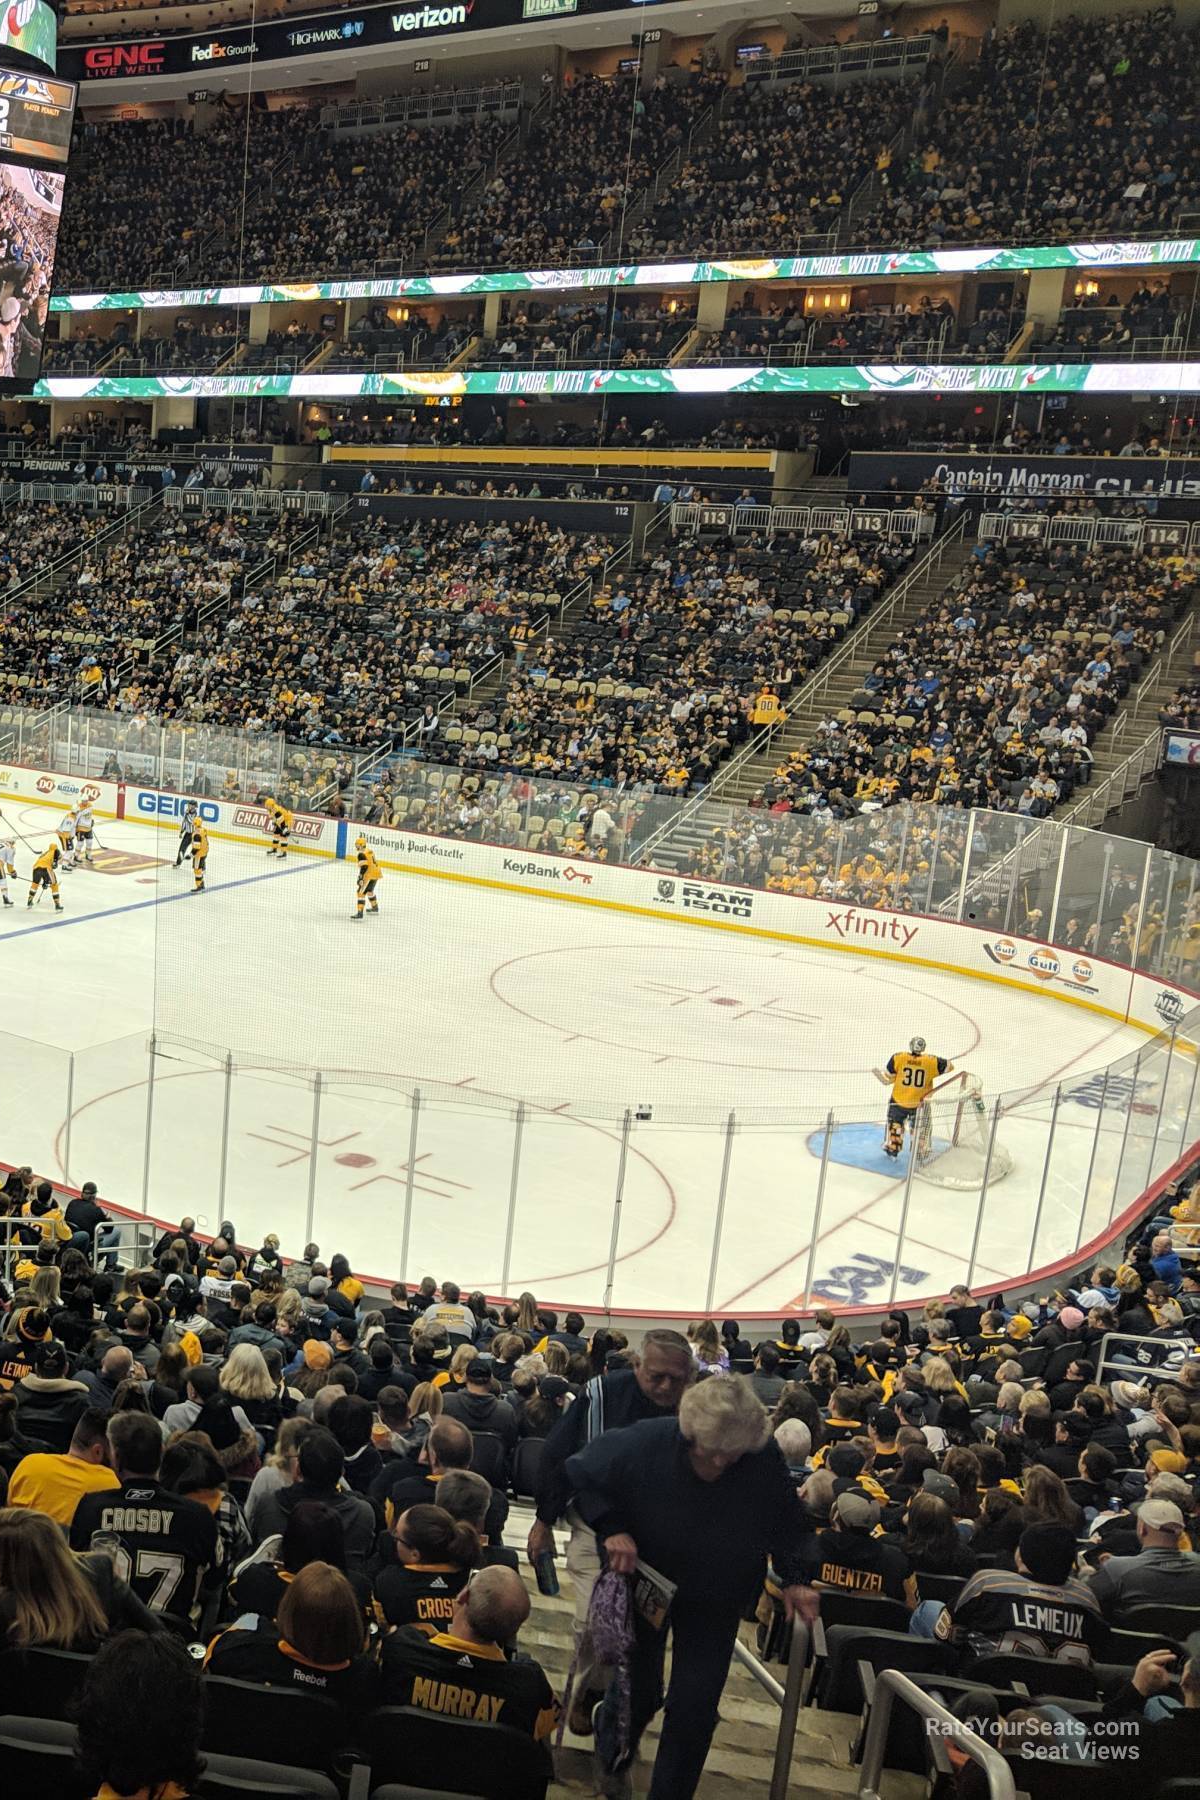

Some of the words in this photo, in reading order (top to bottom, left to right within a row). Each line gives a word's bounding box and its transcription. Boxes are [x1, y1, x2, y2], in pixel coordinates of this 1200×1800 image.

[859, 3, 878, 14] 220
[392, 5, 466, 32] verizon
[291, 28, 341, 46] HIGHMARK
[645, 32, 661, 42] 219
[85, 43, 165, 69] GNC
[192, 43, 226, 61] FedEx
[87, 66, 118, 77] LIVE
[126, 64, 162, 75] WELL
[415, 61, 428, 71] 218
[195, 91, 207, 101] 217
[24, 103, 41, 113] PLAYER
[41, 106, 60, 116] PENALTY
[1162, 241, 1196, 261] WITH
[792, 260, 807, 275] DO
[812, 257, 846, 275] MORE
[849, 254, 880, 272] WITH
[586, 270, 611, 286] WITH
[331, 283, 342, 297] DO
[345, 280, 369, 296] MORE
[370, 279, 393, 295] WITH
[229, 376, 251, 392] WITH
[497, 375, 512, 392] DO
[514, 373, 548, 392] MORE
[553, 372, 585, 391] WITH
[978, 368, 1017, 387] WITH
[23, 460, 71, 471] PENGUINS
[934, 463, 1003, 494] Captain
[1003, 467, 1086, 497] Morgan
[99, 491, 113, 501] 110
[186, 494, 199, 504] 111
[286, 497, 300, 508] 111
[358, 498, 369, 506] 112
[615, 506, 628, 516] 112
[703, 511, 726, 525] 113
[856, 517, 882, 531] 113
[1012, 522, 1041, 537] 114
[1150, 529, 1180, 544] 114
[760, 700, 773, 711] 00
[39, 777, 54, 790] DQ
[83, 786, 98, 799] DQ
[137, 791, 220, 824] GEICO
[359, 831, 406, 851] Pittsburgh
[407, 839, 464, 860] Post-Gazette
[503, 858, 561, 879] KeyBank
[682, 887, 753, 908] RAM
[683, 898, 752, 918] 1500
[825, 908, 919, 948] xfinity
[994, 944, 1017, 956] Gulf
[1029, 956, 1060, 972] Gulf
[1072, 964, 1094, 977] Gulf
[1155, 999, 1185, 1018] NHL
[902, 1067, 926, 1088] 30
[100, 1507, 174, 1535] CROSBY
[1011, 1602, 1085, 1640] LEMIEUX
[293, 1668, 328, 1688] Reebok
[411, 1675, 505, 1723] MURRAY
